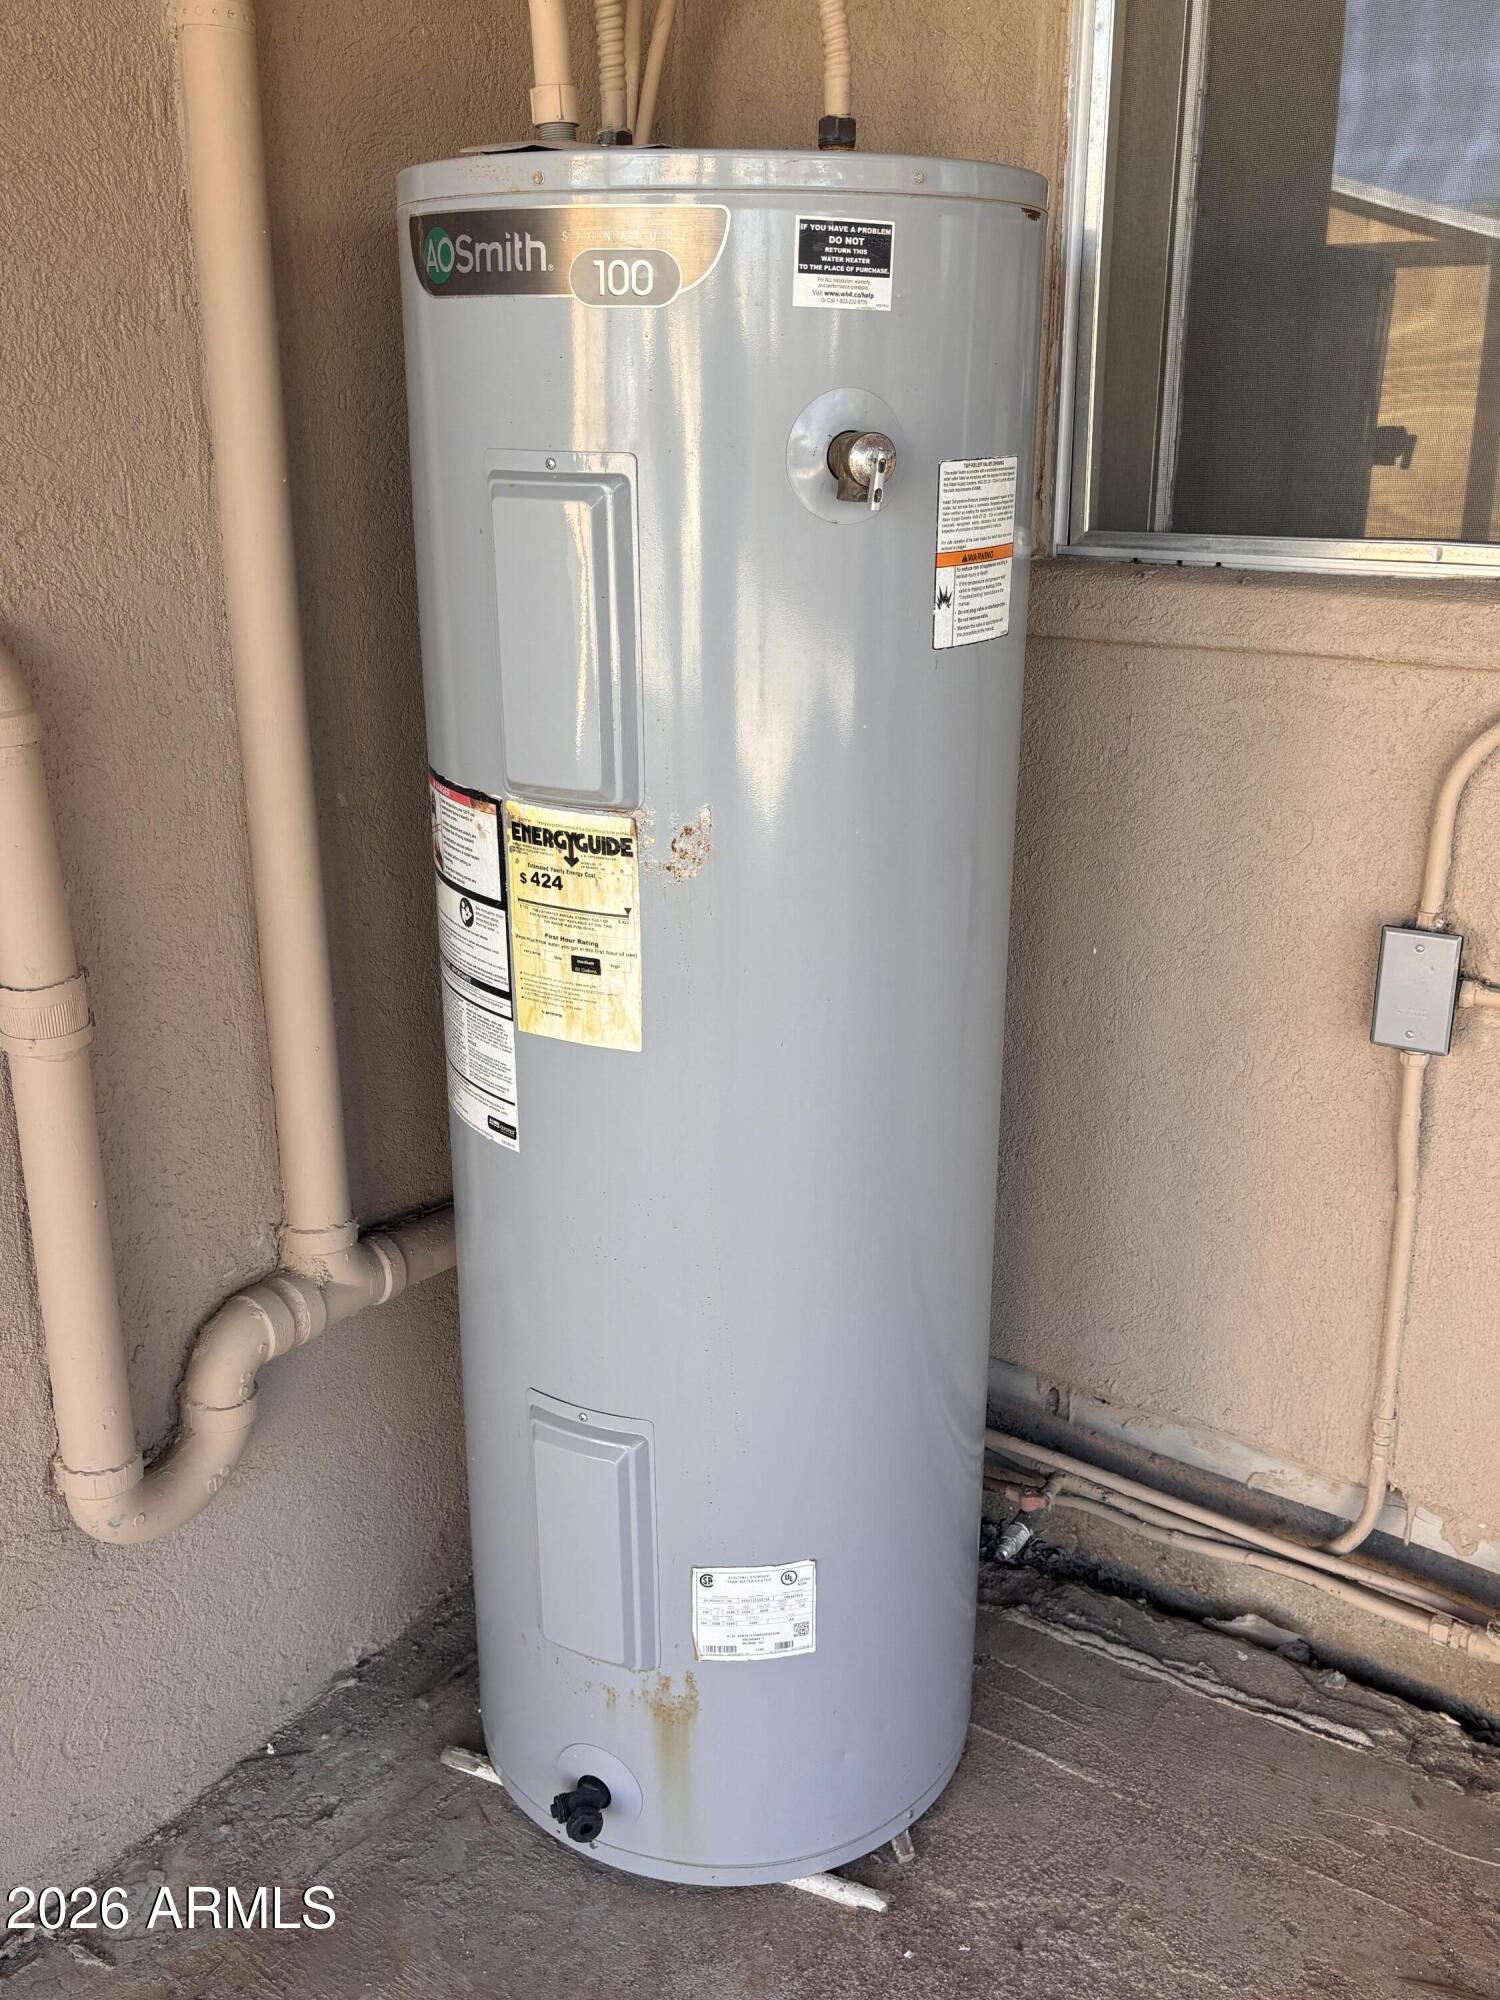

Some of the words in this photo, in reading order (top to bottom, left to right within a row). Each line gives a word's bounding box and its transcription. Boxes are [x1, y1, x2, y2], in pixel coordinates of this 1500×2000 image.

[858, 227, 891, 235] PROBLEM
[829, 236, 842, 244] DO
[845, 237, 865, 245] NOT
[856, 267, 890, 275] PURCHASE.
[592, 259, 653, 296] 100
[511, 821, 633, 857] ENERGYGUIDE
[527, 863, 549, 872] Estimated
[550, 866, 565, 875] Yearly
[566, 869, 583, 878] Energy
[560, 936, 575, 944] Hour
[577, 938, 599, 948] Rating
